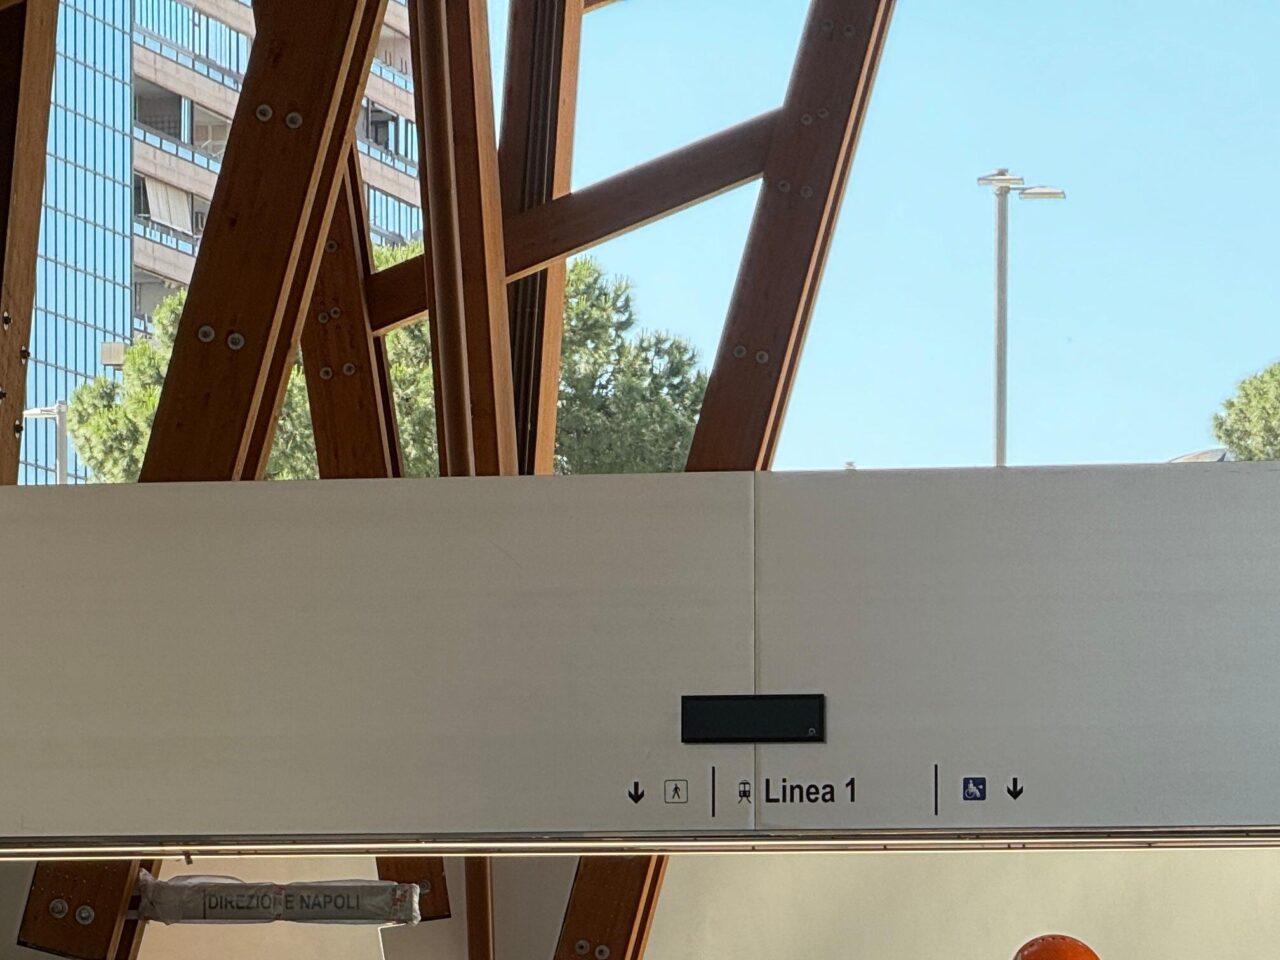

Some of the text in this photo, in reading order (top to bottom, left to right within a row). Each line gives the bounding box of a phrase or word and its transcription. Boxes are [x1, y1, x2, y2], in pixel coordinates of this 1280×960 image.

[765, 777, 856, 803] Linea 1
[299, 893, 360, 910] NAPOLI
